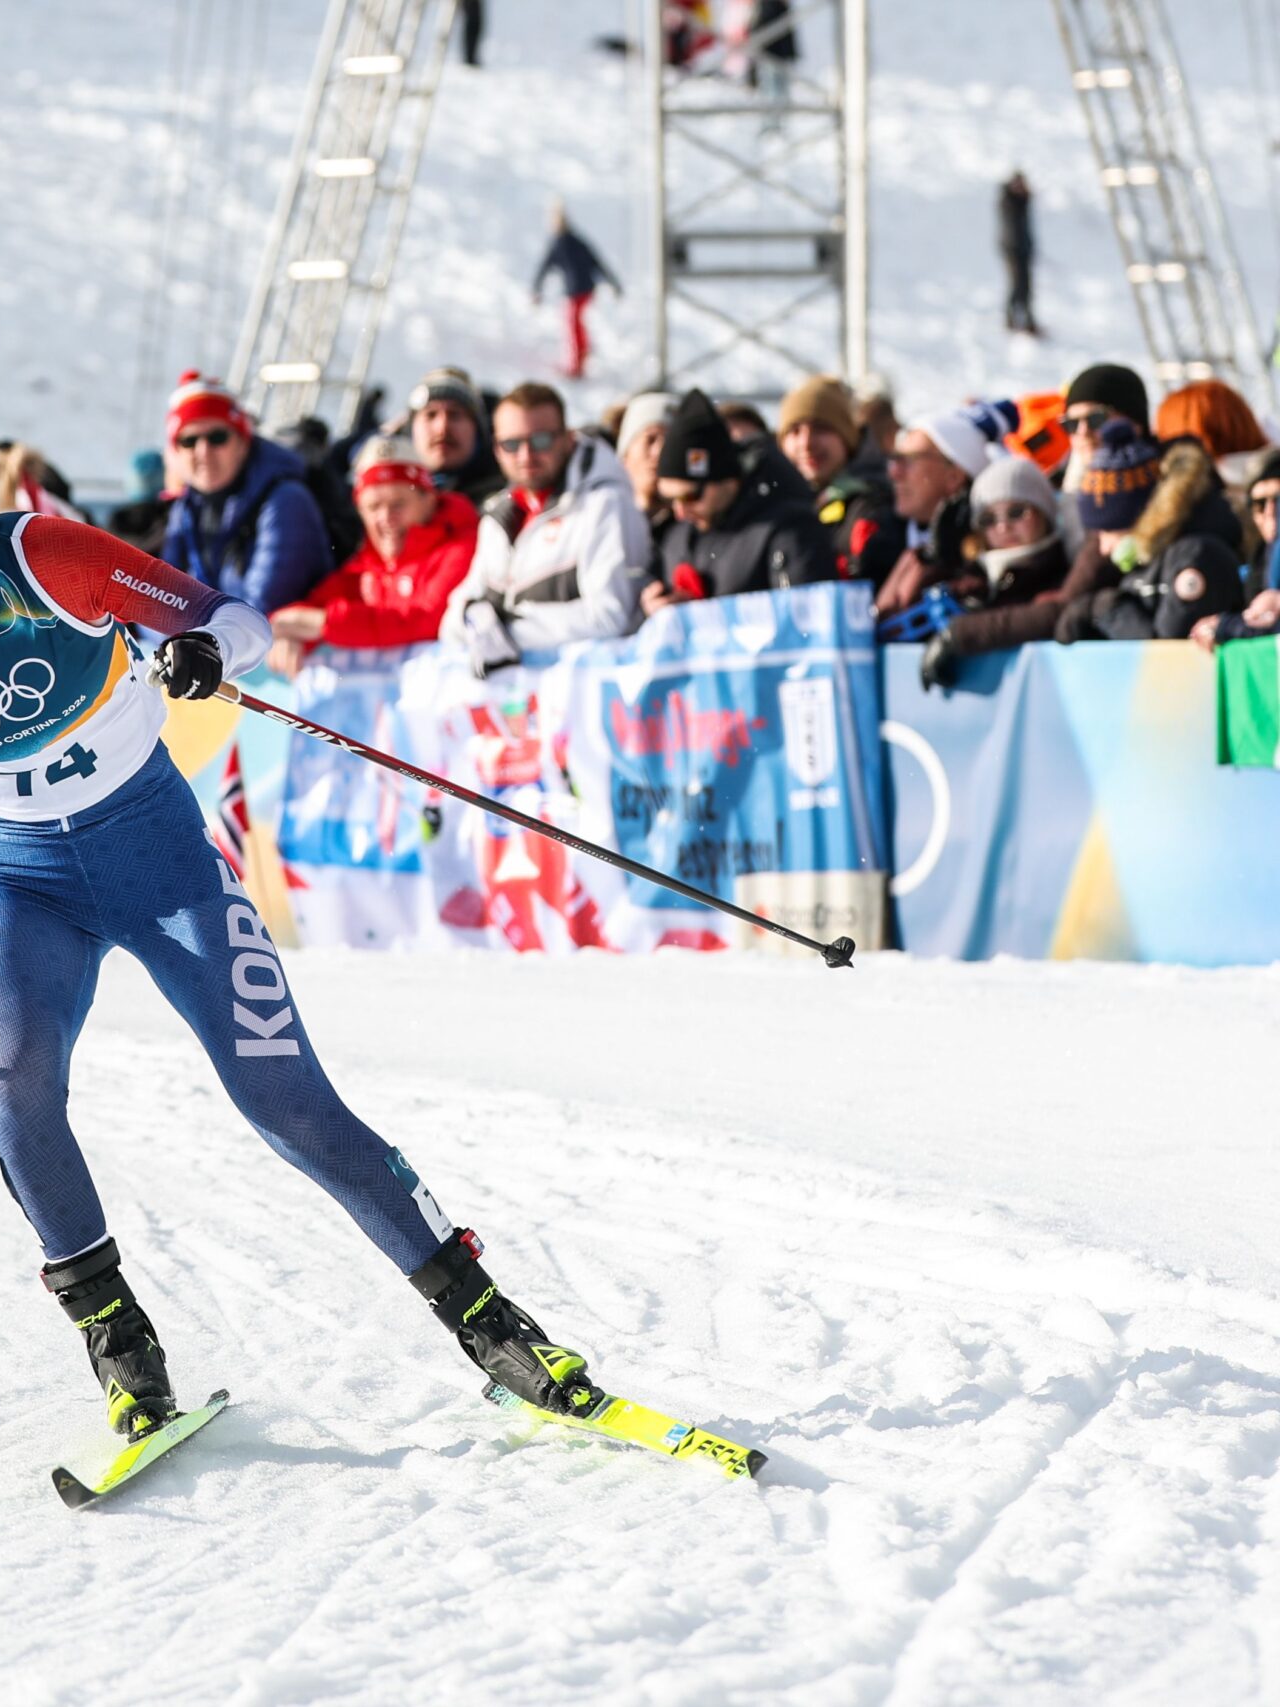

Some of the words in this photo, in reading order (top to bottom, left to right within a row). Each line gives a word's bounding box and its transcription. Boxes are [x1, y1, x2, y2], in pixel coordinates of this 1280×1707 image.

[111, 568, 189, 611] SALOMON
[3, 717, 62, 744] CORTINA
[62, 693, 87, 717] 2026
